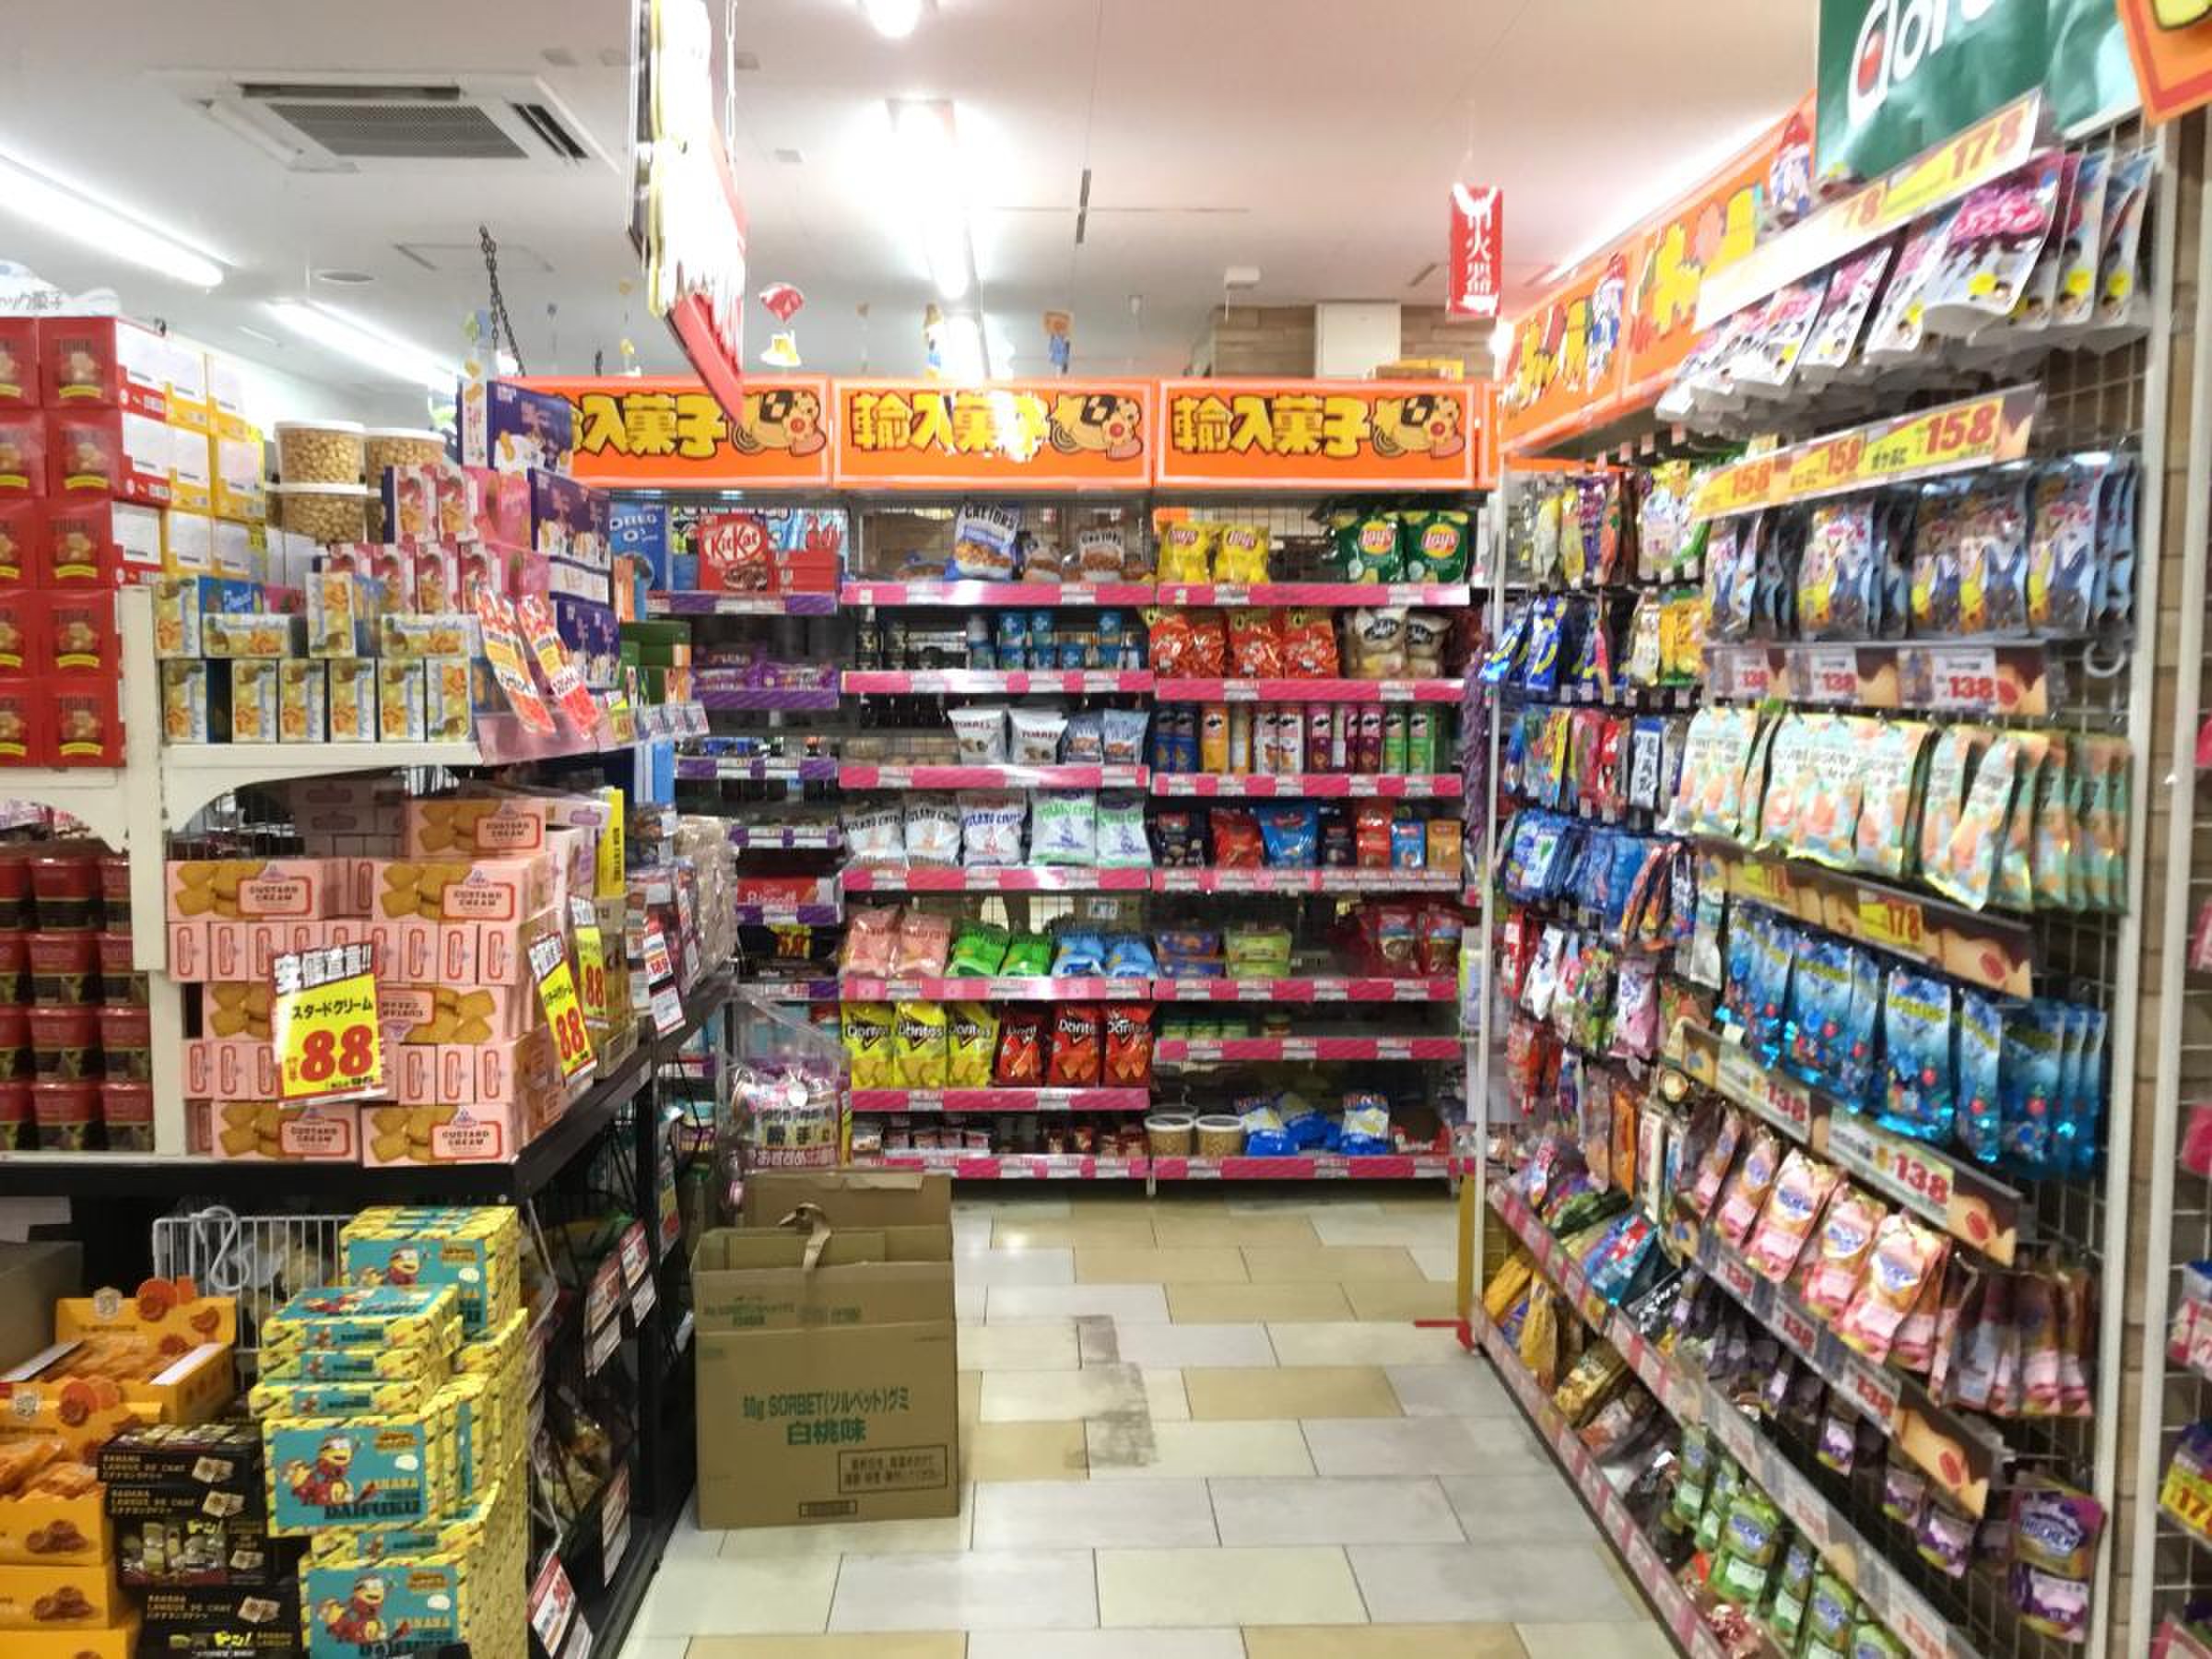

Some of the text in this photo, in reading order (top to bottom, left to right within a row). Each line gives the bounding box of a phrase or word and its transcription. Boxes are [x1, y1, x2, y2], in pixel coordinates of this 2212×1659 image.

[1171, 394, 1371, 458] 輸入菓子
[1925, 404, 1998, 454] 158
[705, 523, 759, 559] KitKat
[1948, 676, 1994, 699] 138
[292, 996, 373, 1020] スタードクリーム
[556, 1006, 585, 1062] 88
[299, 1024, 373, 1083] 88
[441, 1130, 489, 1138] CUSTARD
[448, 1138, 484, 1147] CREAM
[1896, 1152, 1947, 1204] 138
[787, 1418, 866, 1445] 白桃味
